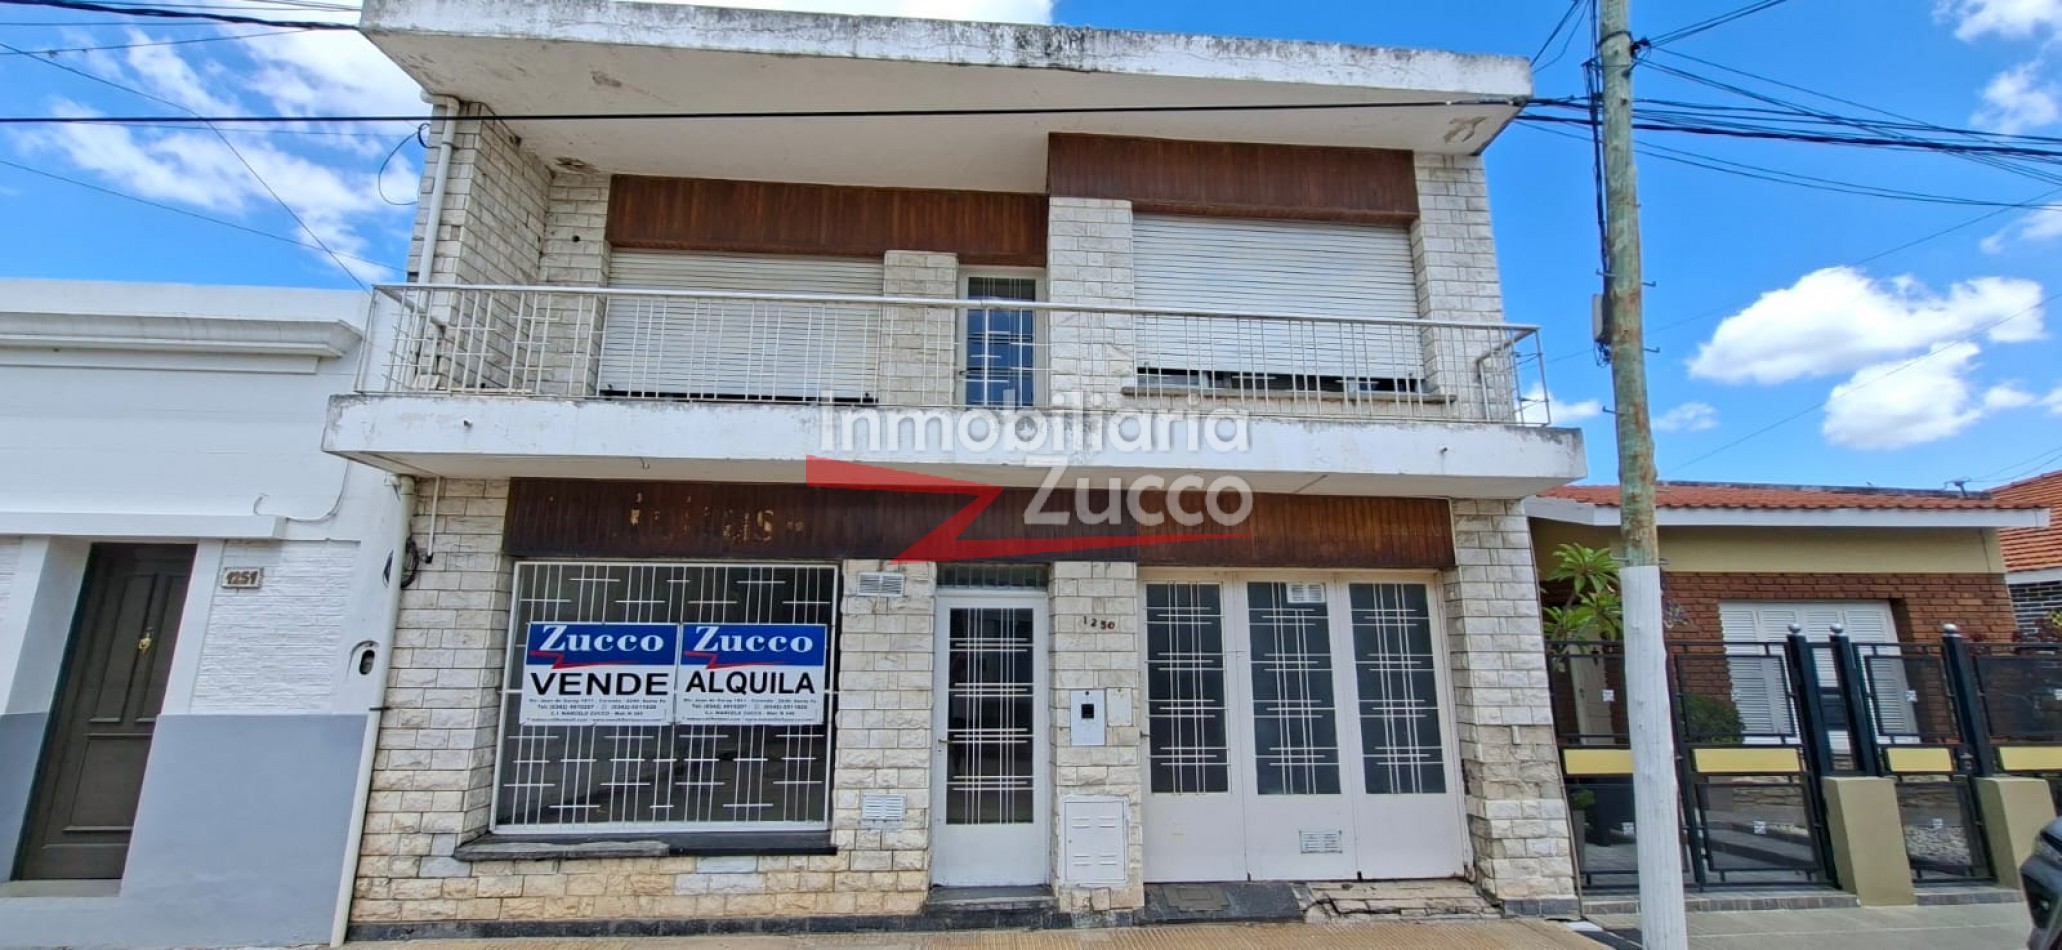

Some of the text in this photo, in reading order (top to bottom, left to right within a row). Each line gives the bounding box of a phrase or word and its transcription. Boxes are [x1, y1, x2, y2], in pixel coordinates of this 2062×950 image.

[226, 570, 259, 585] 1251
[539, 624, 664, 652] Zucco
[692, 626, 814, 653] Zucco
[530, 672, 669, 696] VENDE
[685, 670, 815, 695] ALQUILA
